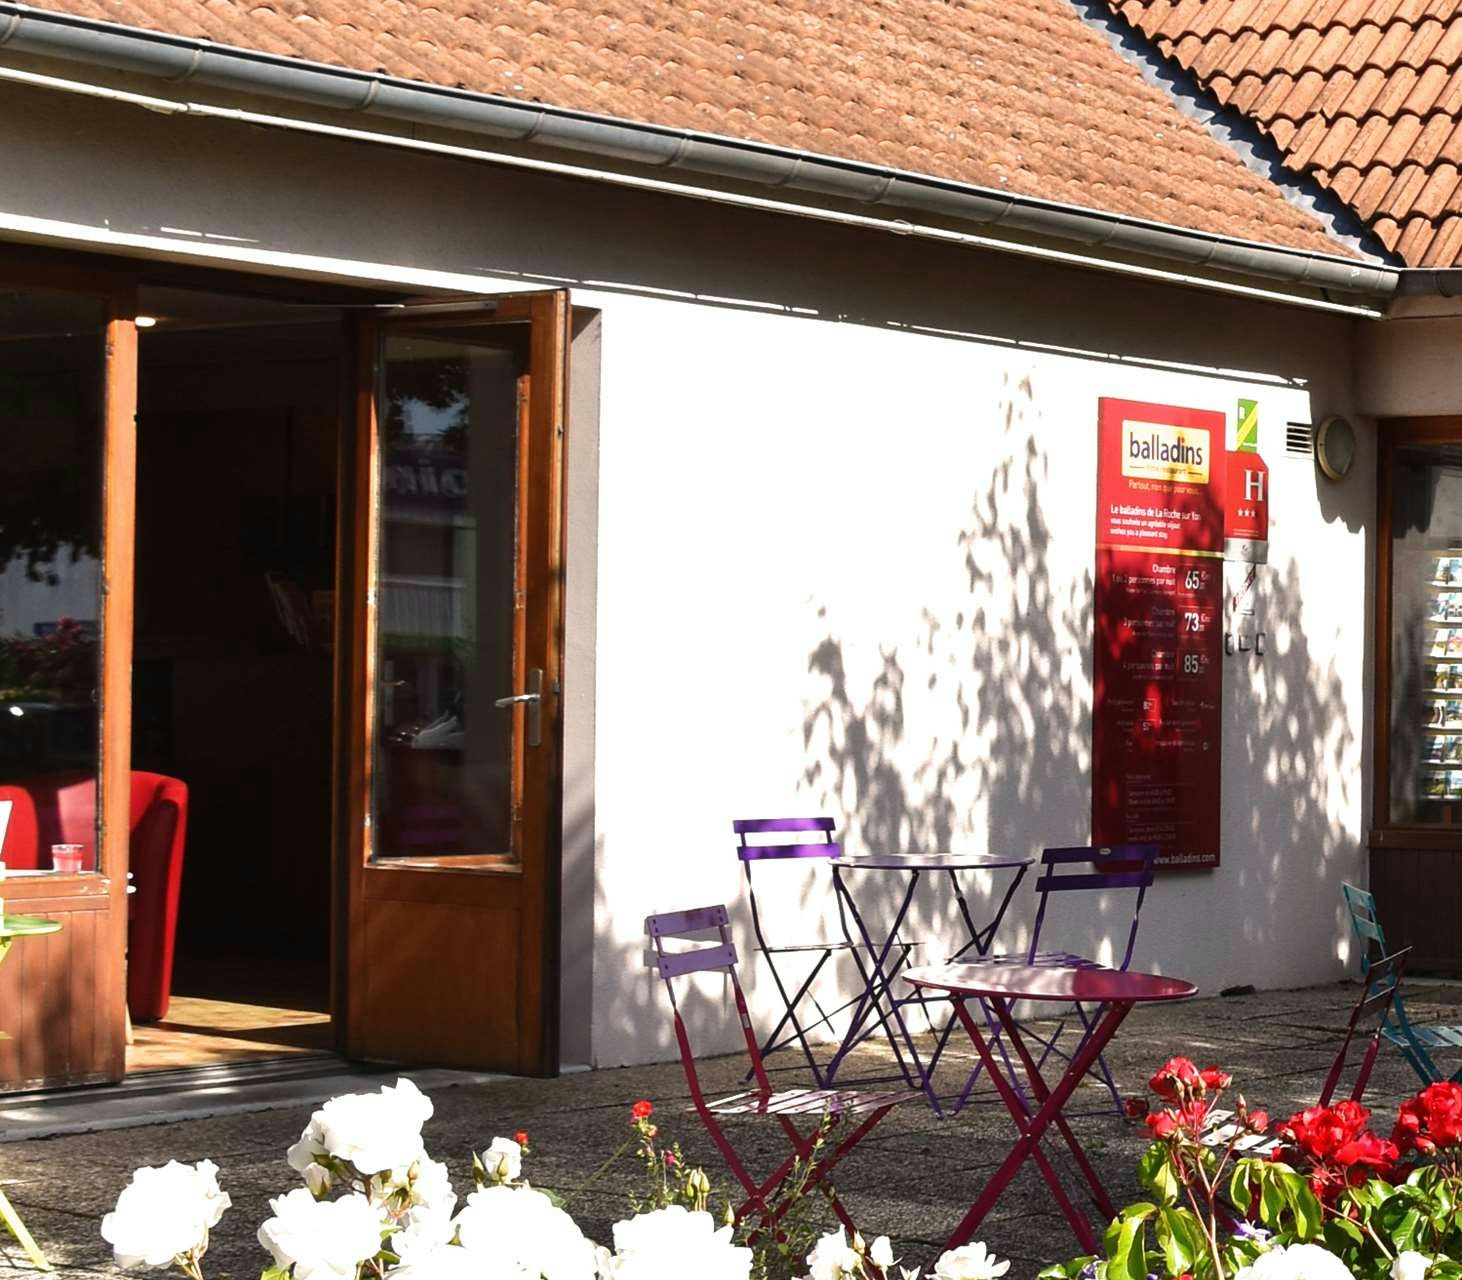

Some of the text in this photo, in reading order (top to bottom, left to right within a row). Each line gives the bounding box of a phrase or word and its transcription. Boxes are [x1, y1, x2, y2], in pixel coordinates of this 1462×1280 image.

[1129, 431, 1203, 465] balladins
[1244, 469, 1264, 501] H
[1185, 570, 1200, 590] 65
[1184, 612, 1200, 632] 73
[1184, 655, 1199, 673] 85
